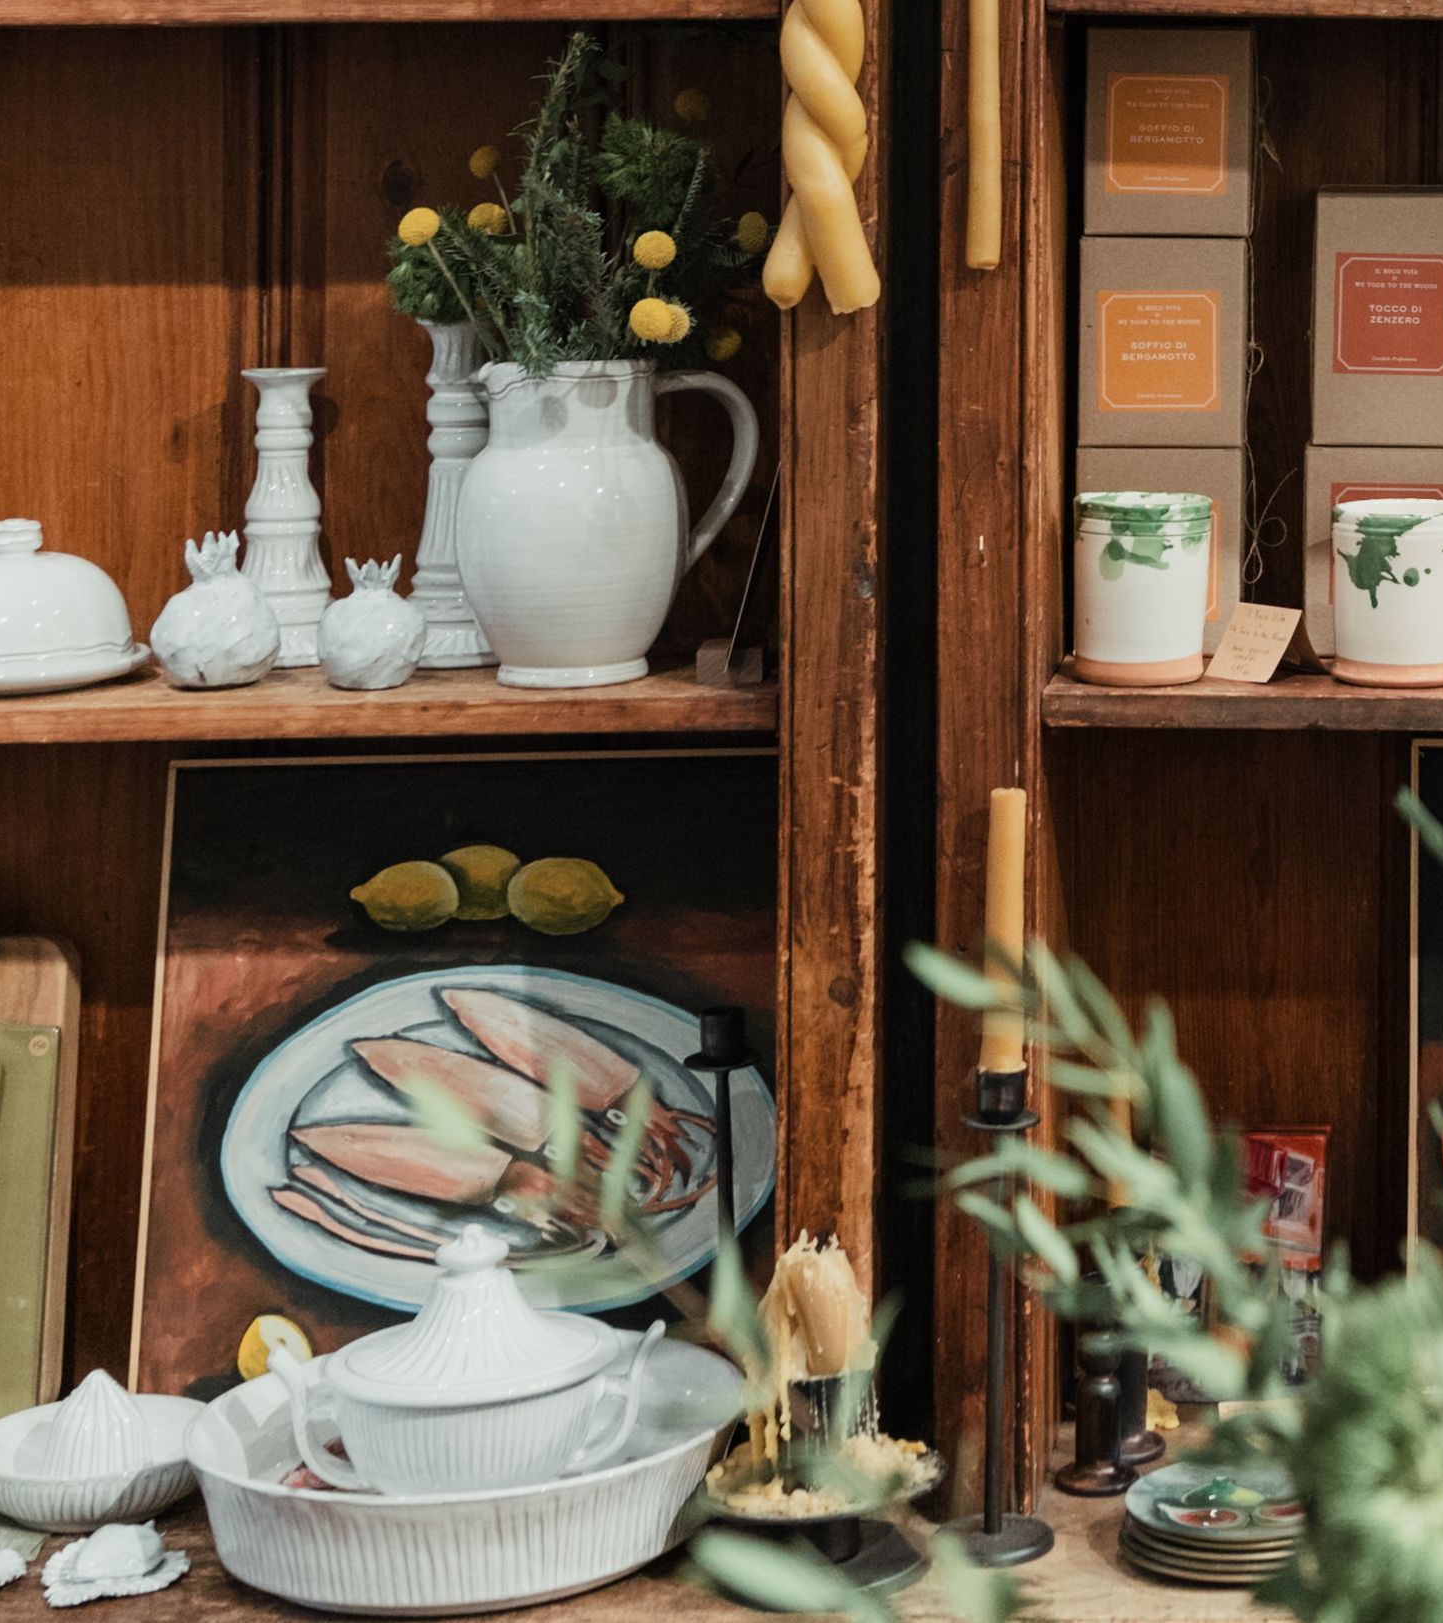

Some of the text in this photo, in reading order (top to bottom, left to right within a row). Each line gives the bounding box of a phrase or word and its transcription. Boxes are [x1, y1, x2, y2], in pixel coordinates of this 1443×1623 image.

[1368, 304, 1422, 313] TOCCO DI
[1369, 315, 1421, 325] ZENZERO
[1130, 341, 1187, 350] SOFFIO DI
[1121, 352, 1197, 361] BERGAMOTTO
